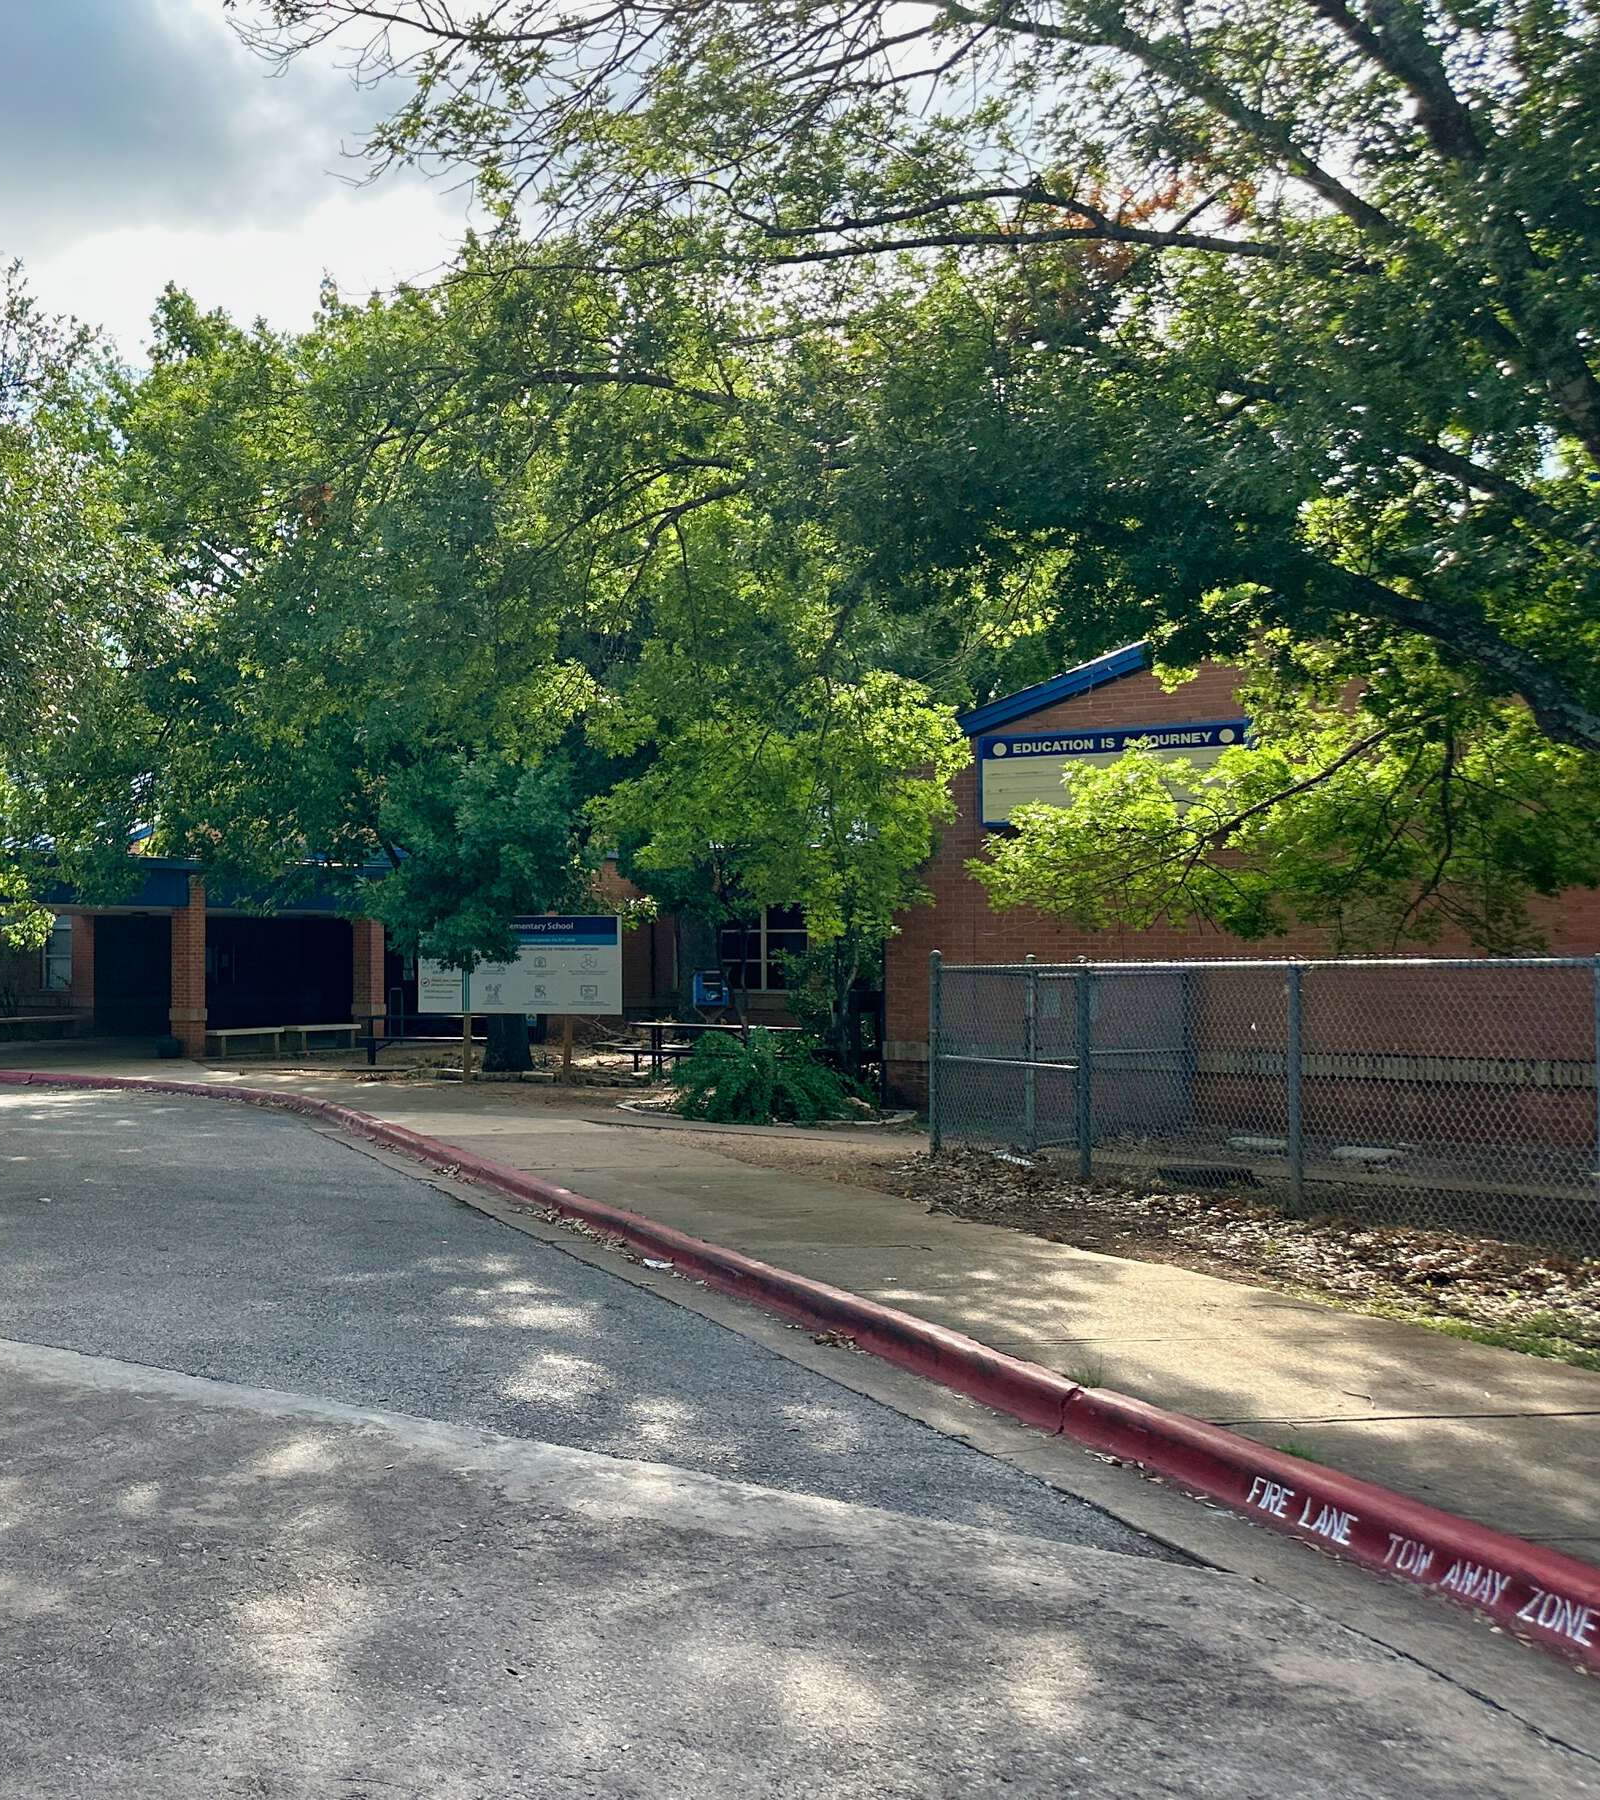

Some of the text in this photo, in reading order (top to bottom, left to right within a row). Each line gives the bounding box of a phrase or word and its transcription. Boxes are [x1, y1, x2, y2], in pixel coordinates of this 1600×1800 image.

[1012, 739, 1094, 754] EDUCATION
[1101, 737, 1115, 749] IS
[1145, 732, 1212, 746] OURNEY
[508, 922, 574, 930] ementary School
[1246, 1476, 1600, 1648] FIRE LANE TOW AWAY ZONE
